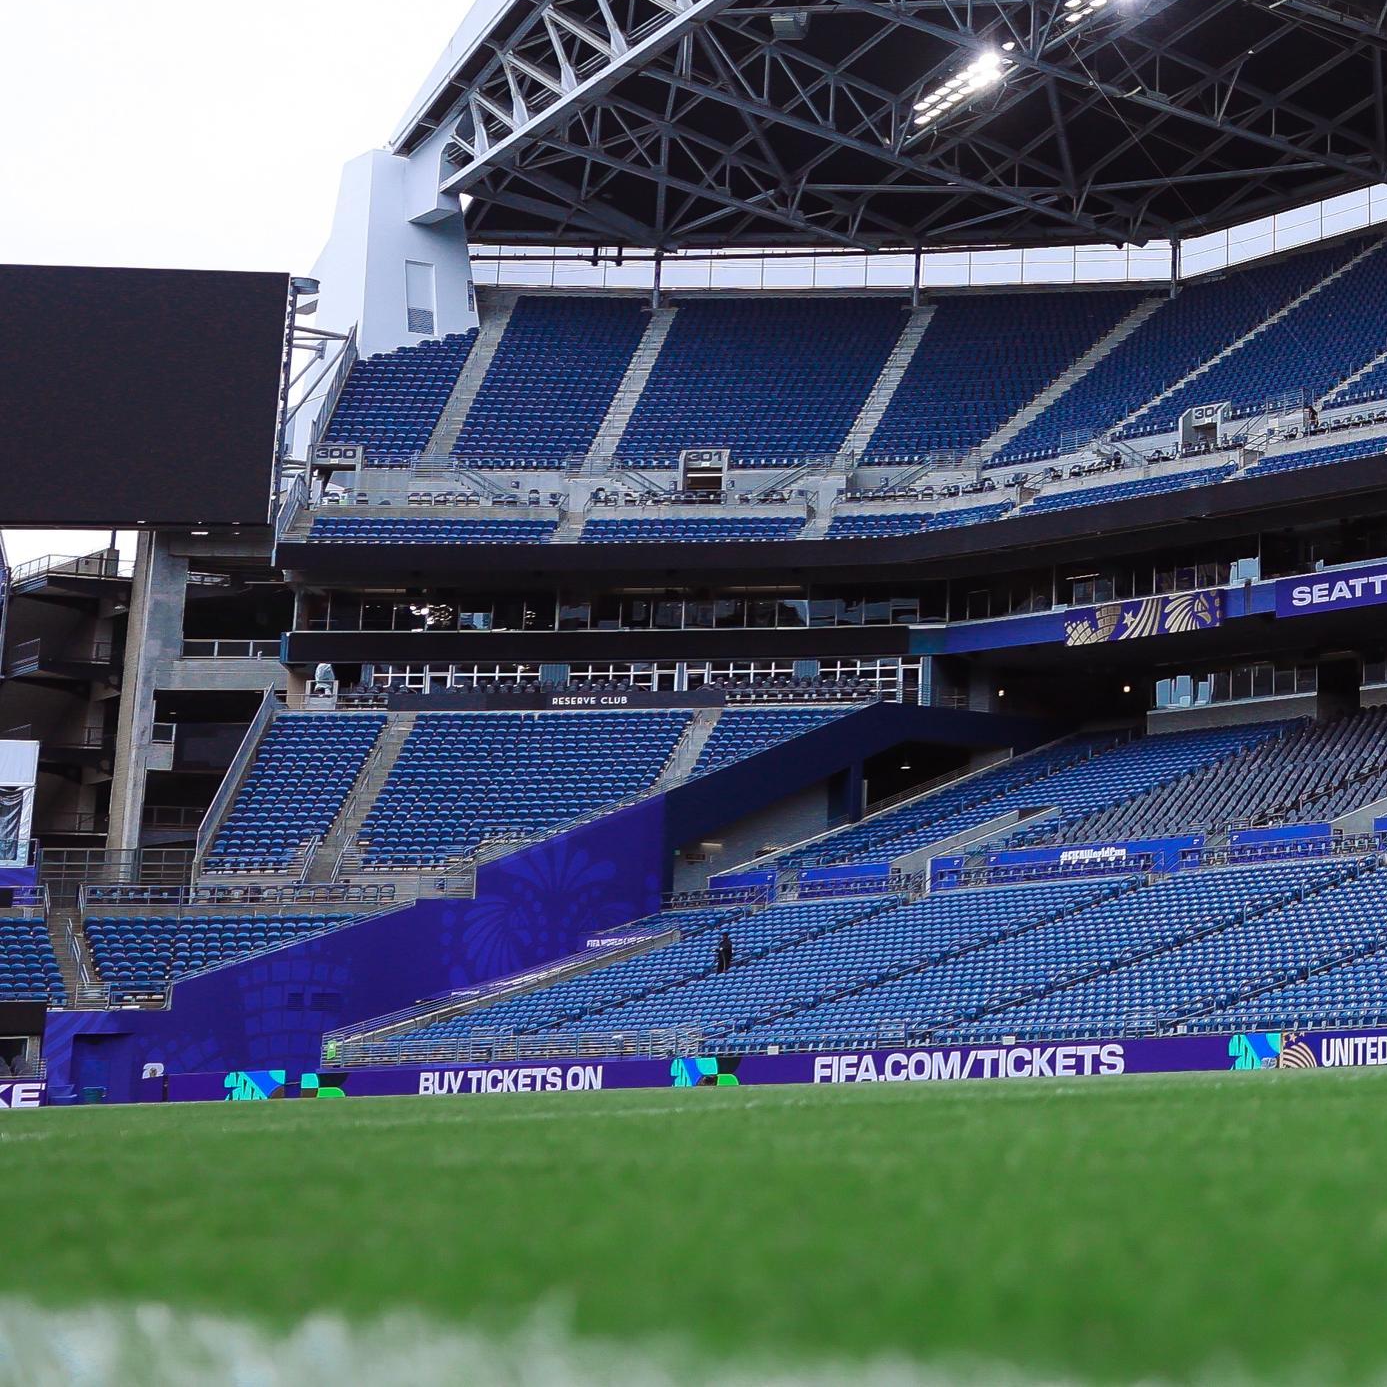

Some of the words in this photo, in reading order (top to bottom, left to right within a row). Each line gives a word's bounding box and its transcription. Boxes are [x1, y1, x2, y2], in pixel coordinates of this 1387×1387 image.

[315, 447, 357, 459] 300
[686, 451, 723, 462] 301
[552, 696, 597, 706] RESERVE
[600, 695, 628, 705] CLUB
[813, 1043, 1125, 1084] FIFA.COM/TICKETS
[419, 1070, 465, 1095] BUY
[467, 1066, 563, 1093] TICKETS
[566, 1065, 603, 1090] ON
